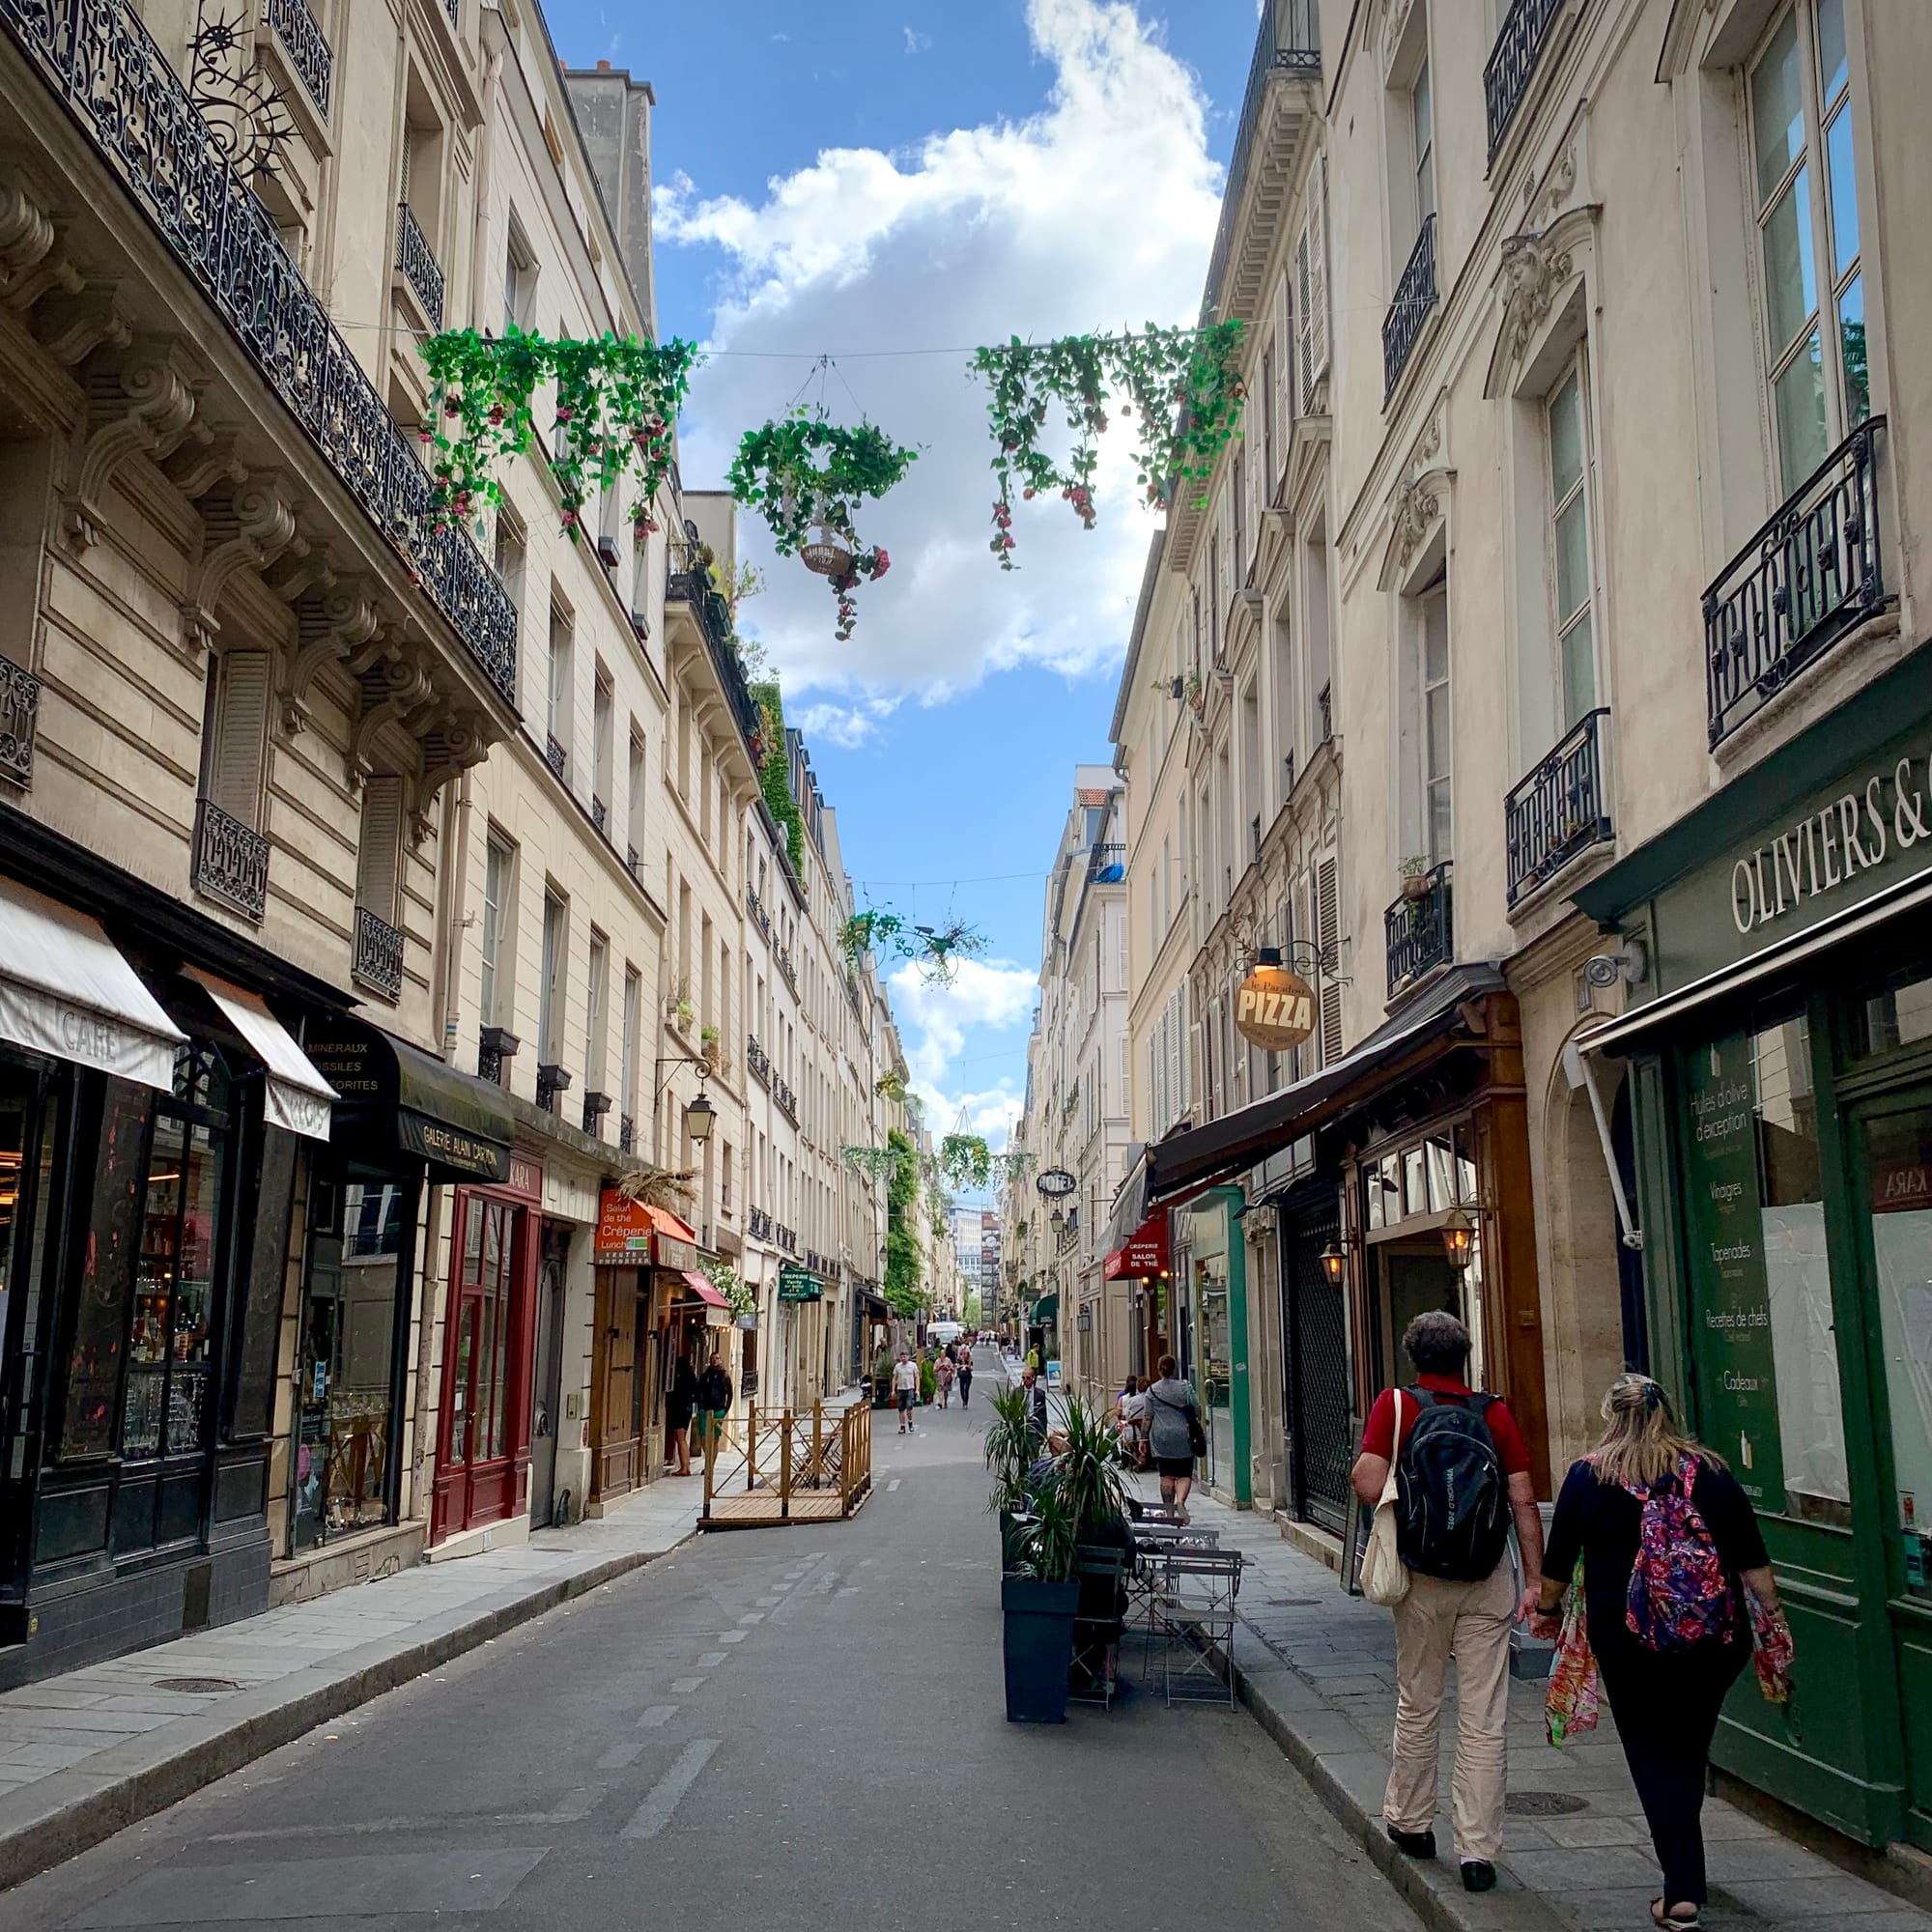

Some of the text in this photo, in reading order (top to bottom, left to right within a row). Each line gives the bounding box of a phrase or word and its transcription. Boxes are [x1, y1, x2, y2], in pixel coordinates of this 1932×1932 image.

[1732, 757, 1931, 933] OLIVIERS &
[1237, 989, 1311, 1030] PIZZA
[315, 1062, 362, 1071] OSSILES
[509, 1161, 530, 1191] KARA
[602, 1225, 652, 1238] Crêperie
[1735, 1307, 1747, 1327] de
